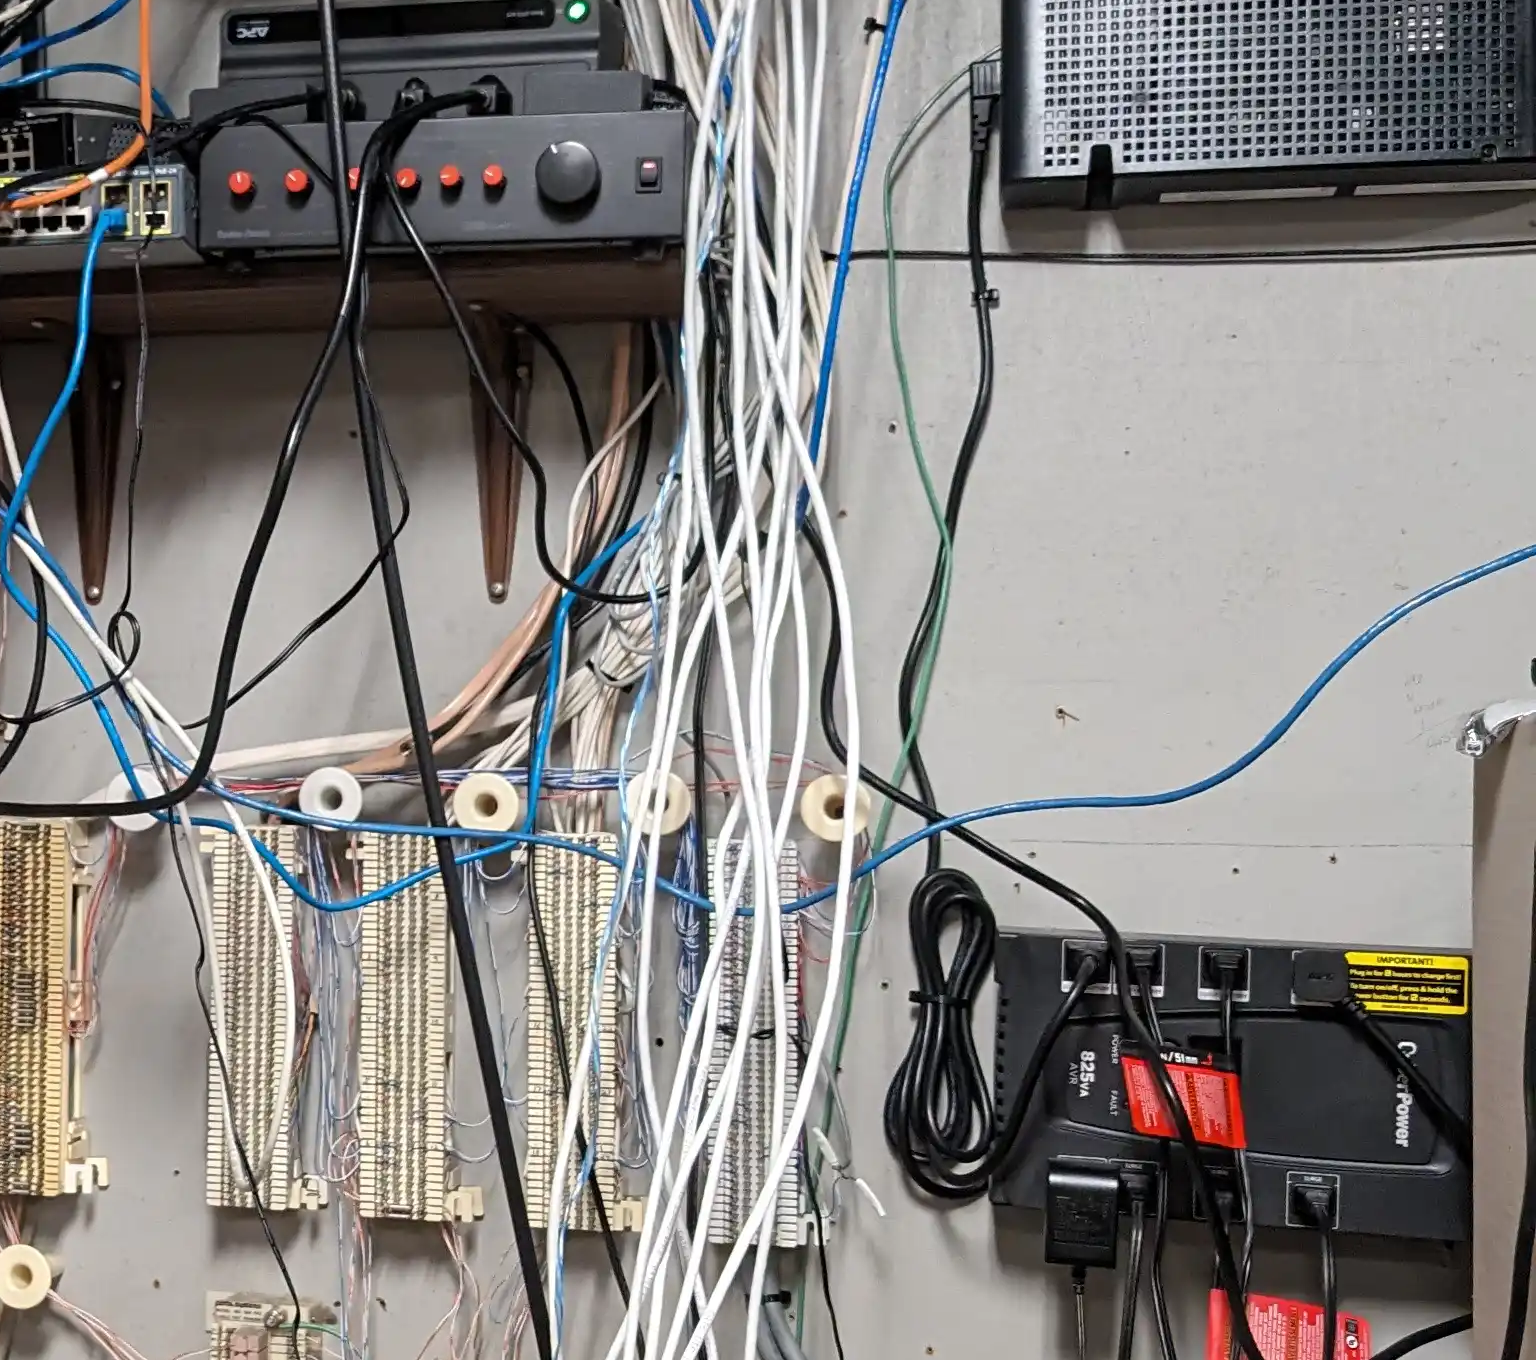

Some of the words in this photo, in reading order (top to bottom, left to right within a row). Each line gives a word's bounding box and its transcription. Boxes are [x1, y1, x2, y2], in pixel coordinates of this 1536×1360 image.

[235, 26, 270, 39] APC
[1376, 955, 1434, 966] IMPORTANT!
[1111, 1034, 1120, 1065] POWER
[1068, 1061, 1078, 1086] AVR
[1078, 1050, 1096, 1099] 825VA
[1109, 1089, 1119, 1117] FAULT
